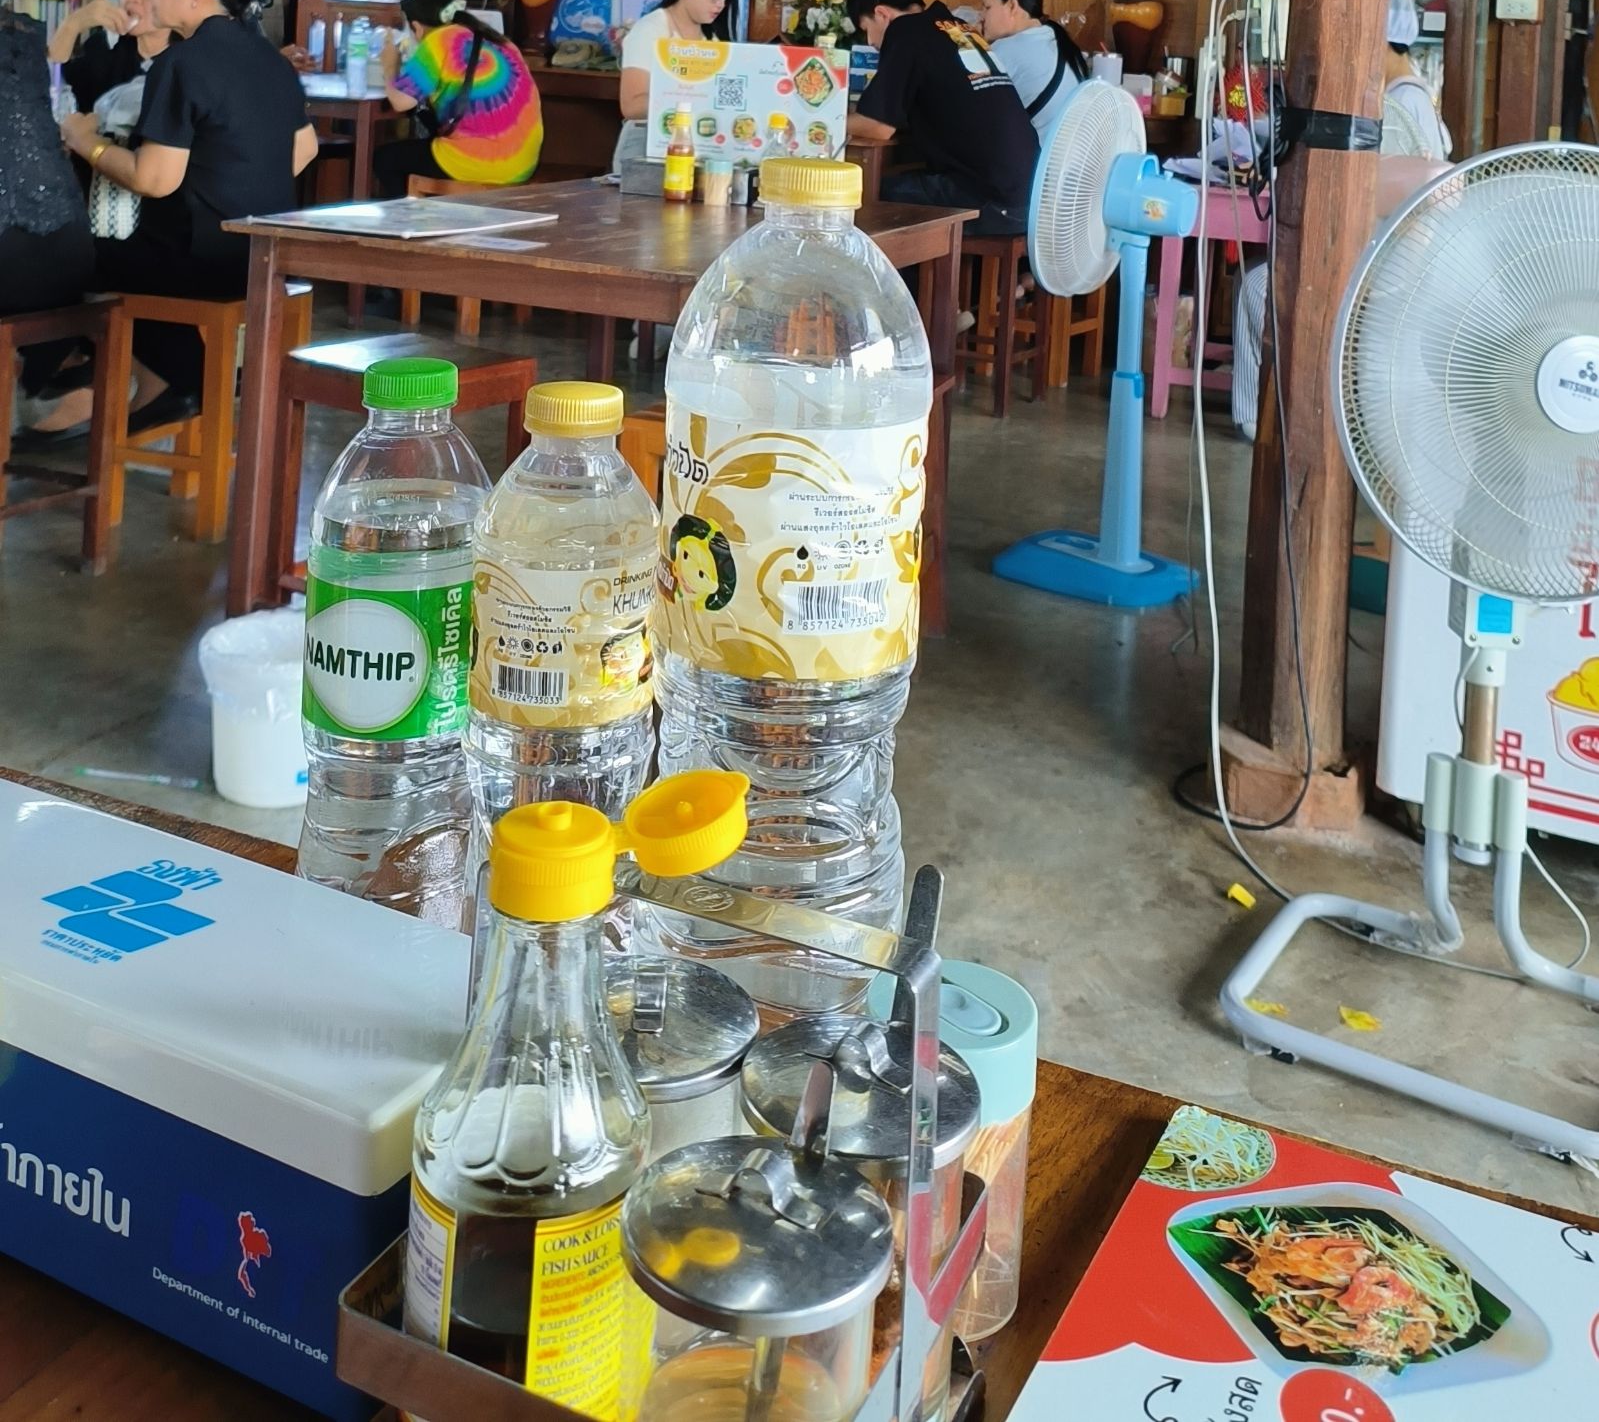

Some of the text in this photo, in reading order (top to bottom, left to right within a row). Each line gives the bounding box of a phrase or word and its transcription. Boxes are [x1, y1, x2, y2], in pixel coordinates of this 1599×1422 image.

[613, 568, 652, 586] DRINKING
[305, 631, 416, 682] NAMTHIP
[136, 859, 223, 890] ธงฟ้า
[41, 929, 123, 962] ราคาประหยัด
[0, 1123, 131, 1238] าภายใน
[543, 1235, 579, 1253] COOK
[583, 1230, 592, 1244] &
[542, 1258, 572, 1275] FISH
[573, 1242, 609, 1267] SAUCE
[152, 1266, 329, 1364] Department of internal trade
